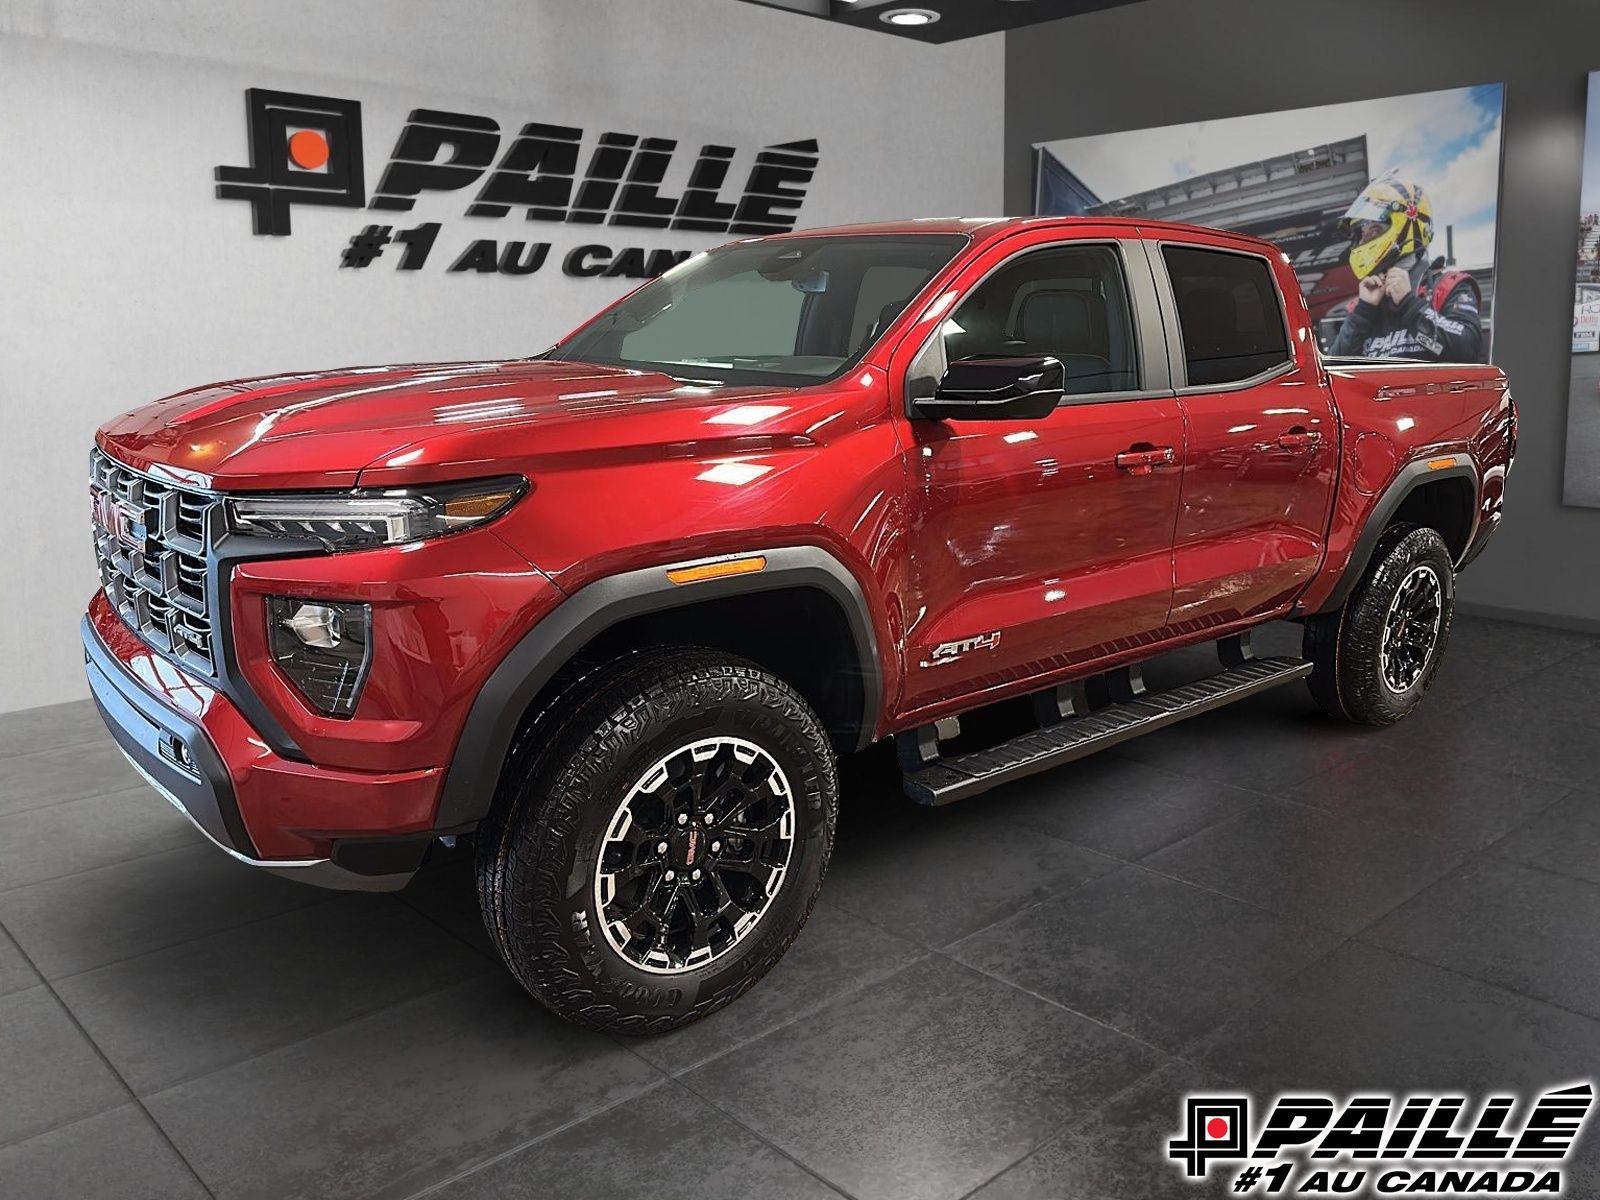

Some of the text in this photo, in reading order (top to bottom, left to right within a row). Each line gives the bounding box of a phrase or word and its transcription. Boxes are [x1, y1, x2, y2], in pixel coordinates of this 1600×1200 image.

[367, 108, 820, 235] PAILLÉ
[339, 221, 695, 279] #1 AU CAN
[931, 631, 1001, 659] AT4
